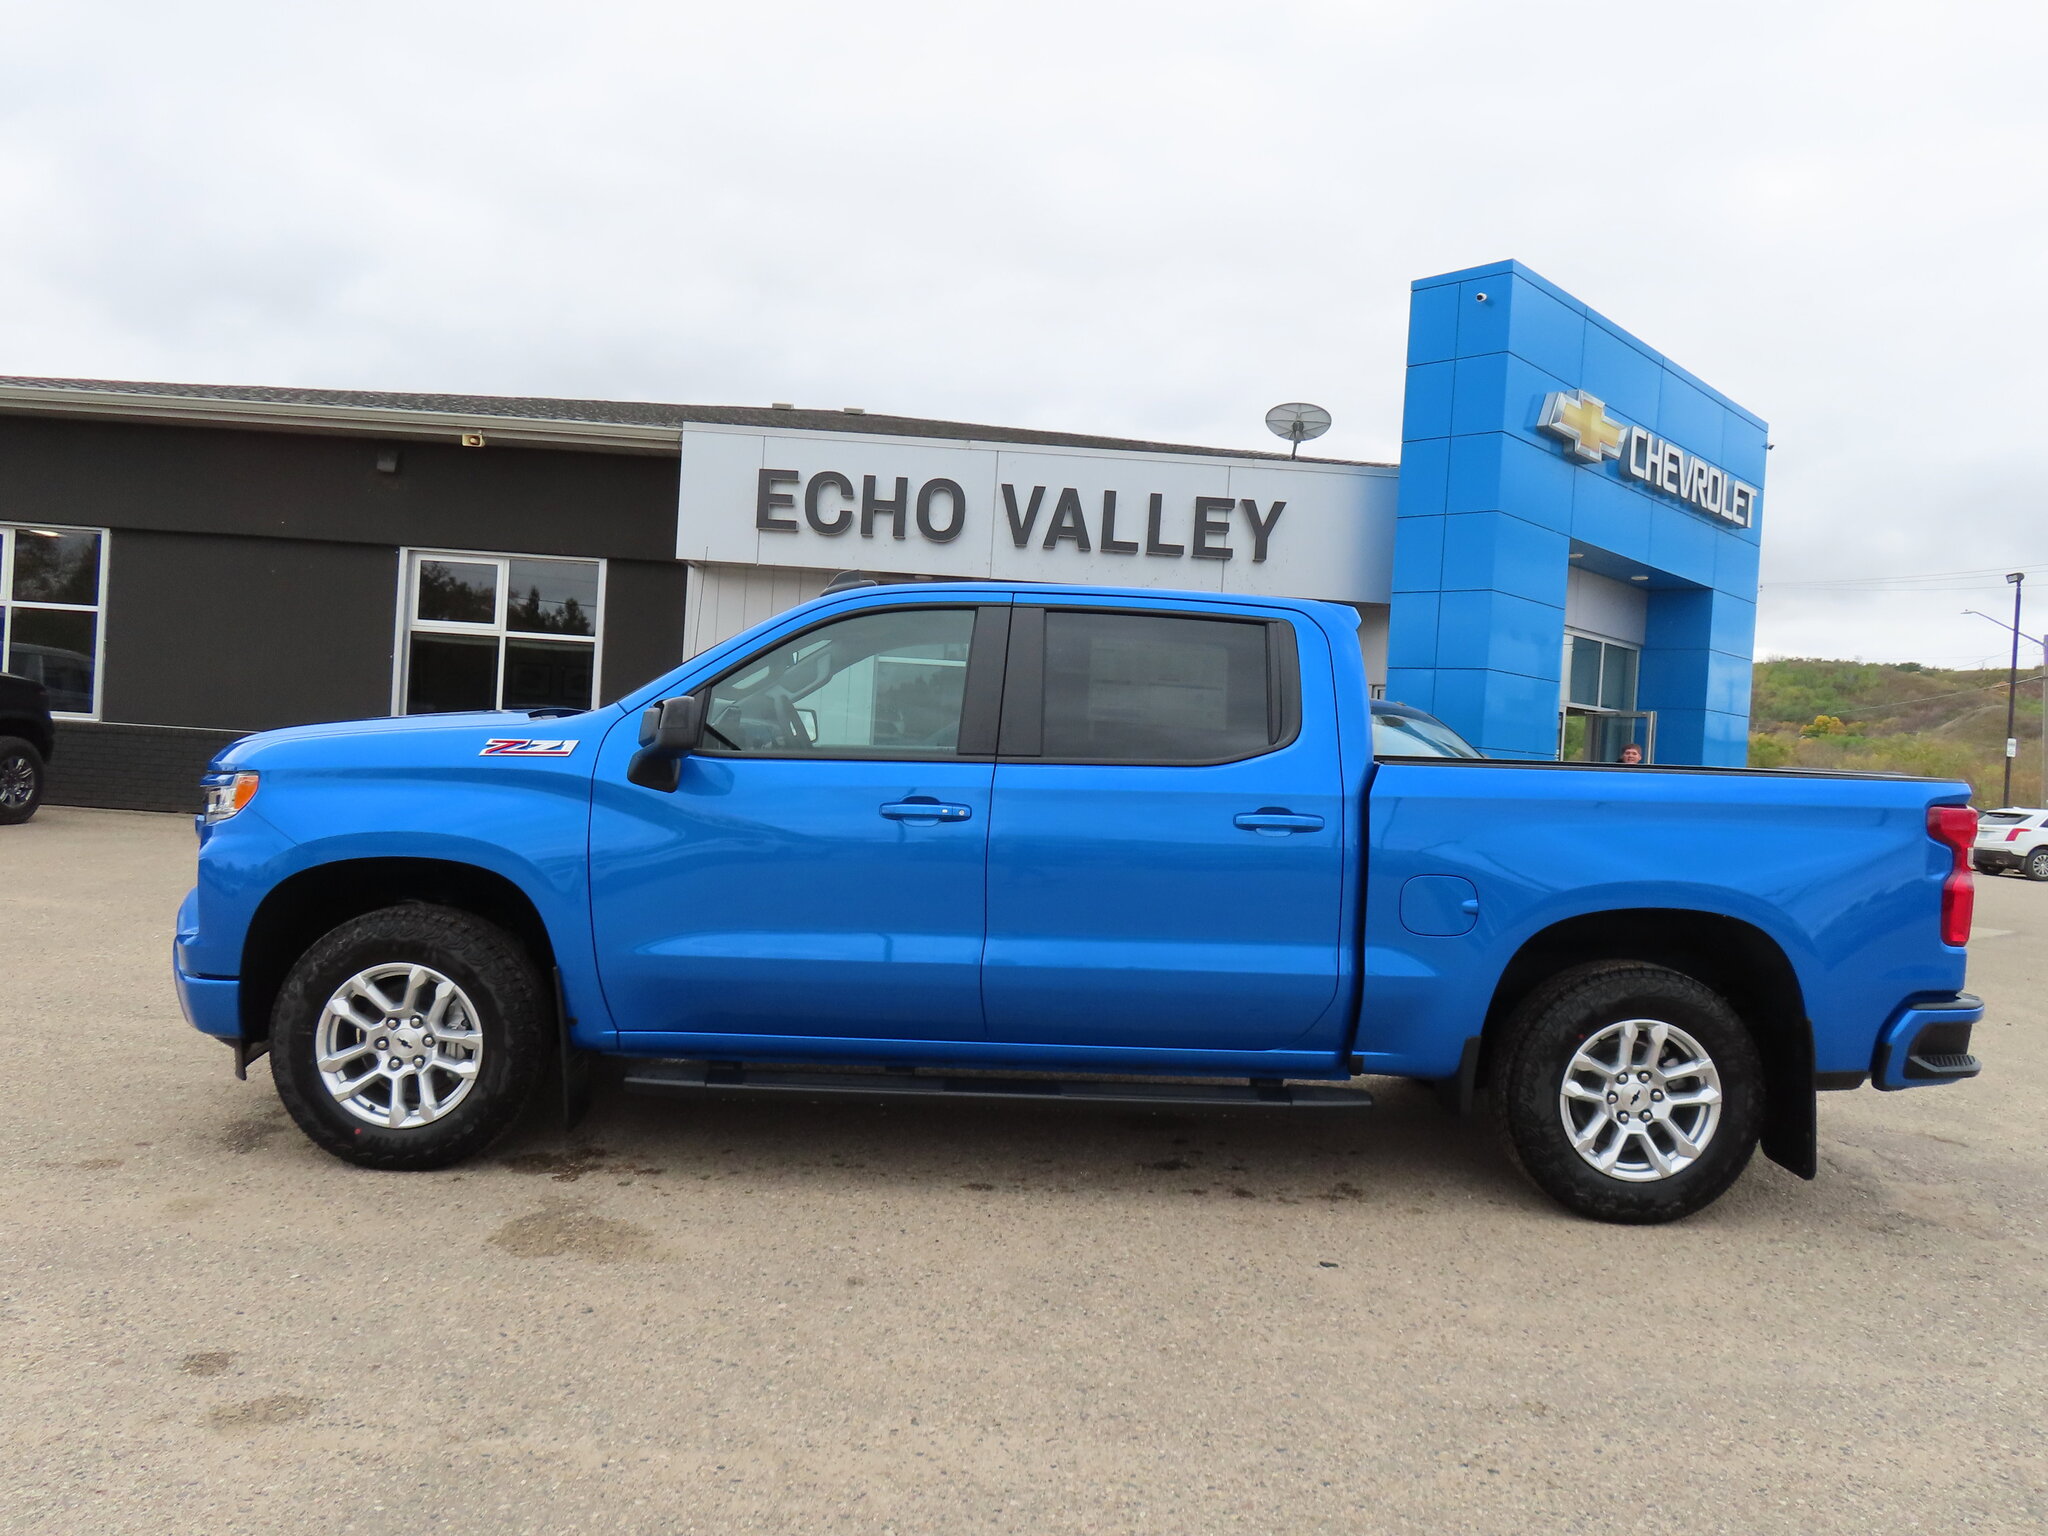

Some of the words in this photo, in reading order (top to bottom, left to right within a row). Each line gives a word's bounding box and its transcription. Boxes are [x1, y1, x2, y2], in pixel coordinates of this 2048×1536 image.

[756, 469, 966, 543] ECHO
[1001, 483, 1287, 562] VALLEY
[1629, 426, 1757, 528] CHEVROLET
